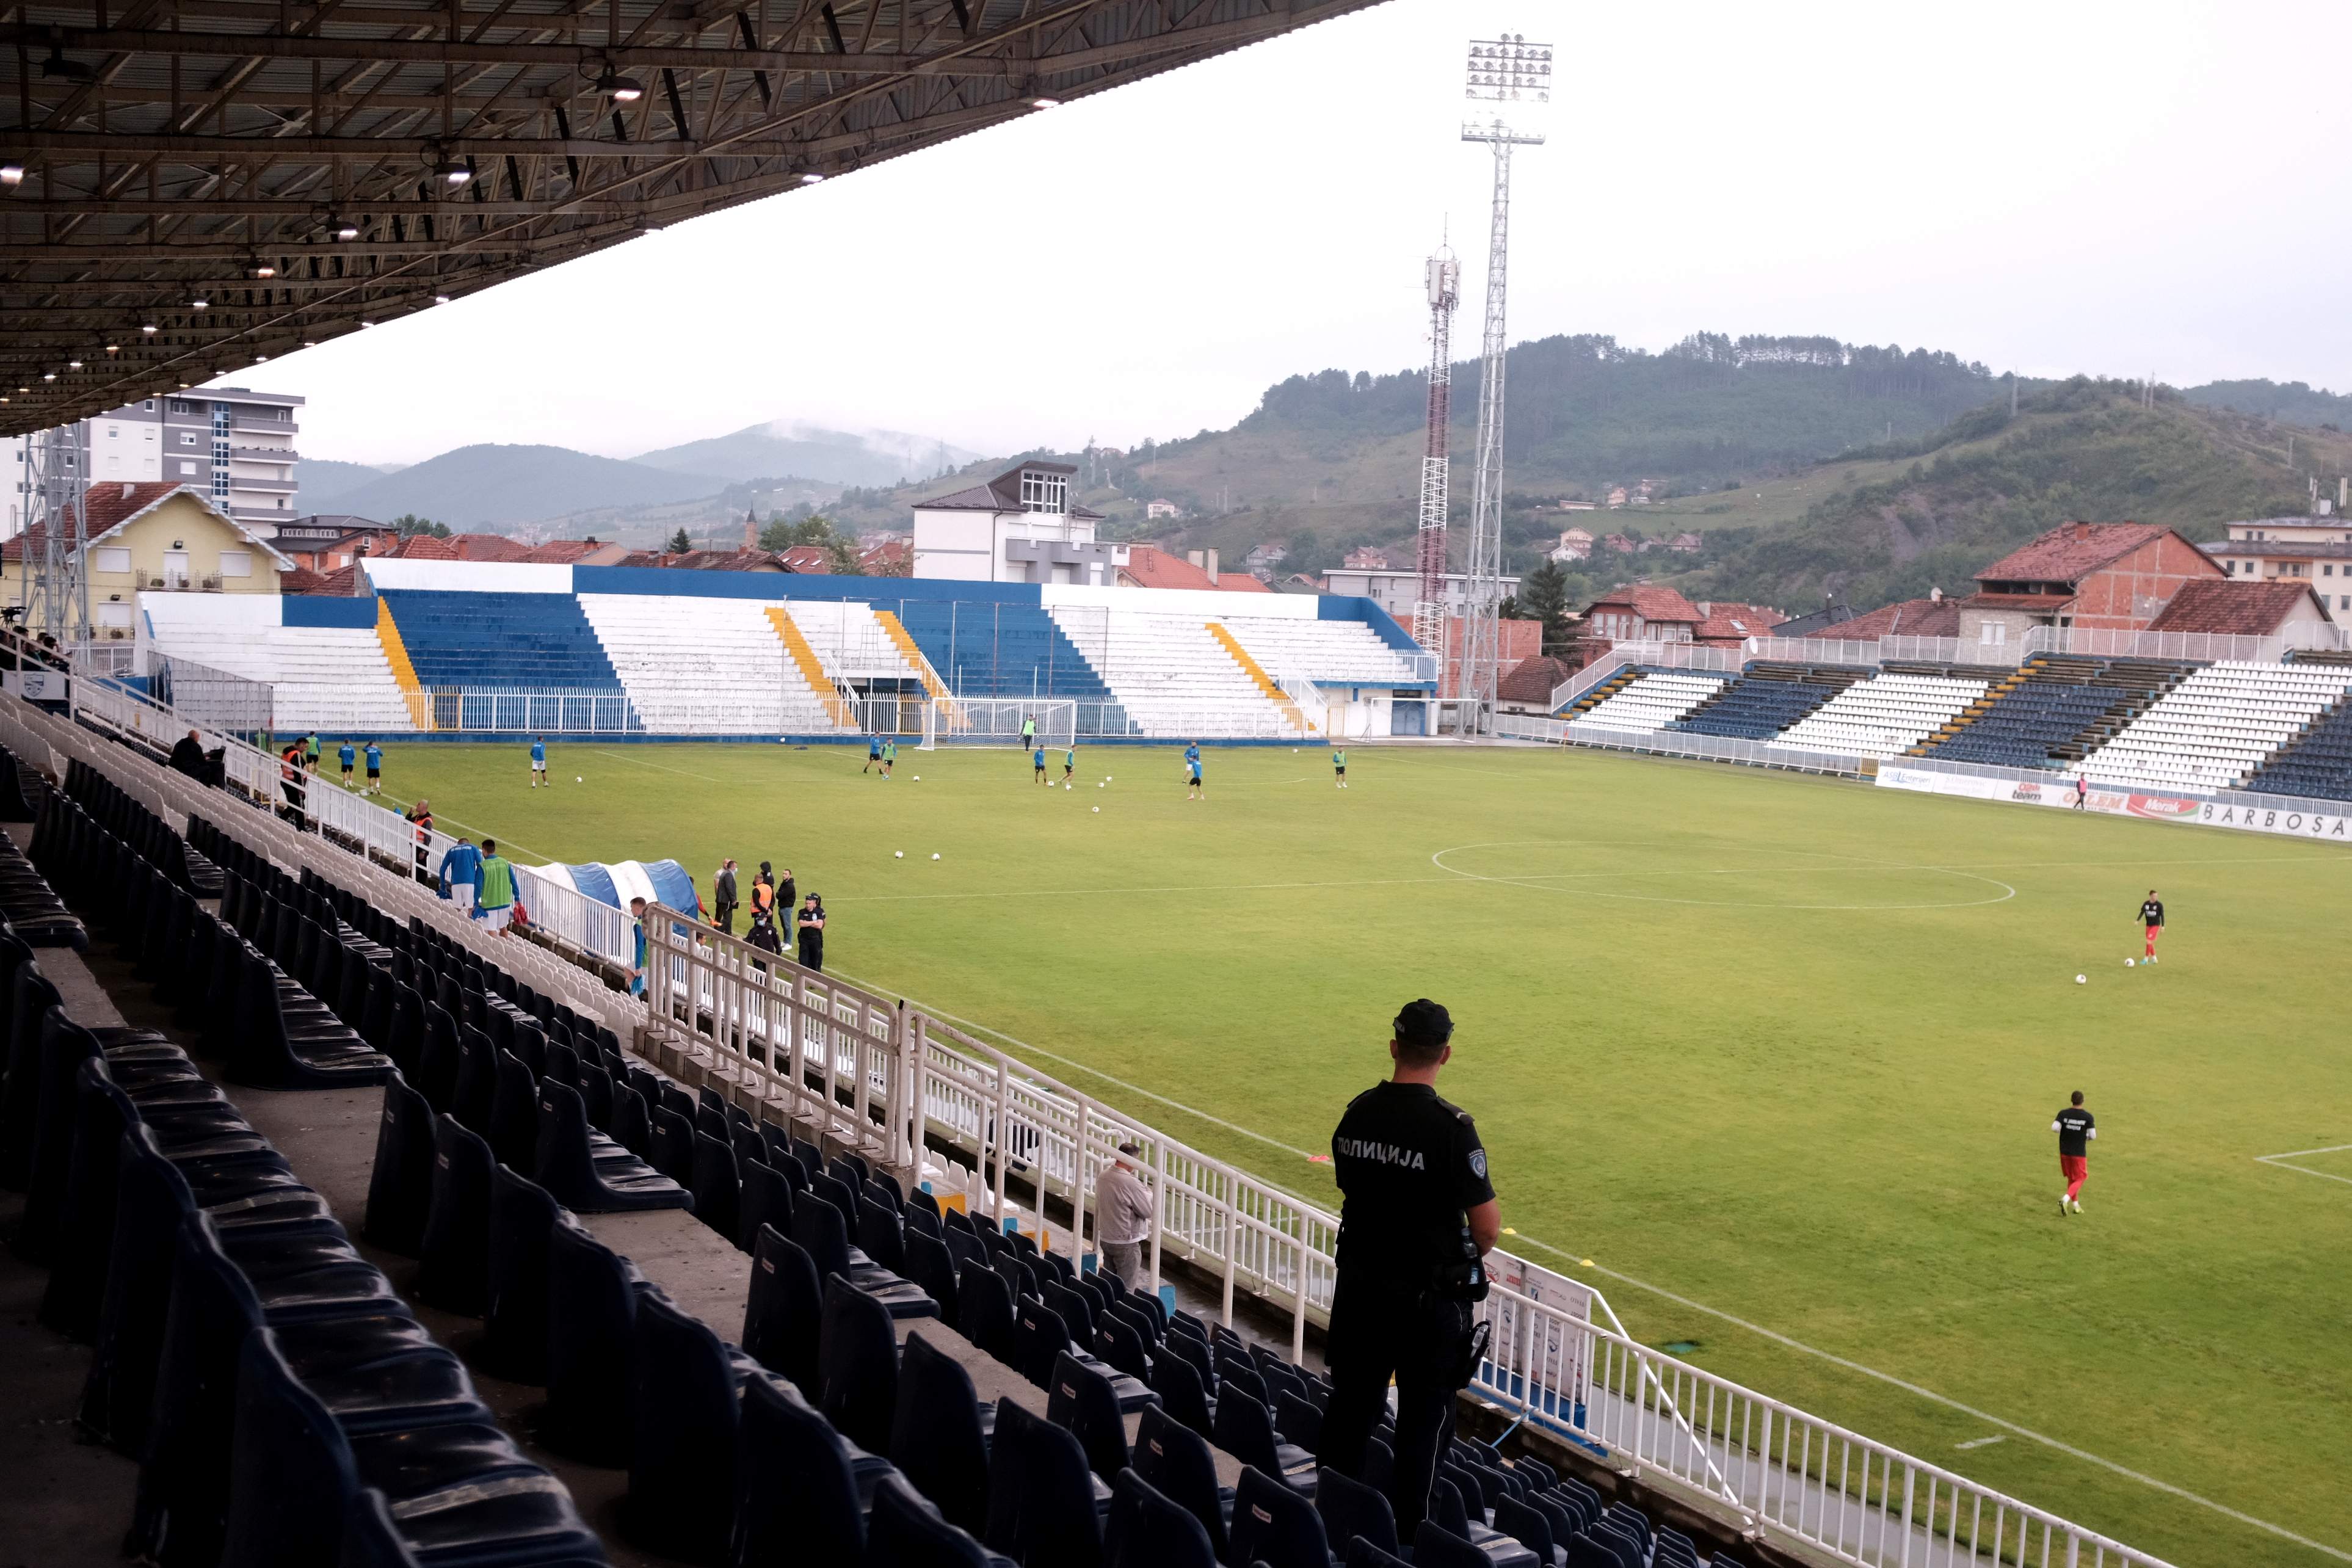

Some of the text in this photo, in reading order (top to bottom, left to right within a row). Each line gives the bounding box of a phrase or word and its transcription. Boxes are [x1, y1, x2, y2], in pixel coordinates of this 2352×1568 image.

[2012, 789, 2041, 800] team
[2063, 792, 2124, 810] OLEM
[2143, 798, 2181, 813] Merak
[2204, 804, 2345, 835] BARBOSA
[1337, 1136, 1425, 1171] ПОЛИЦИЈА
